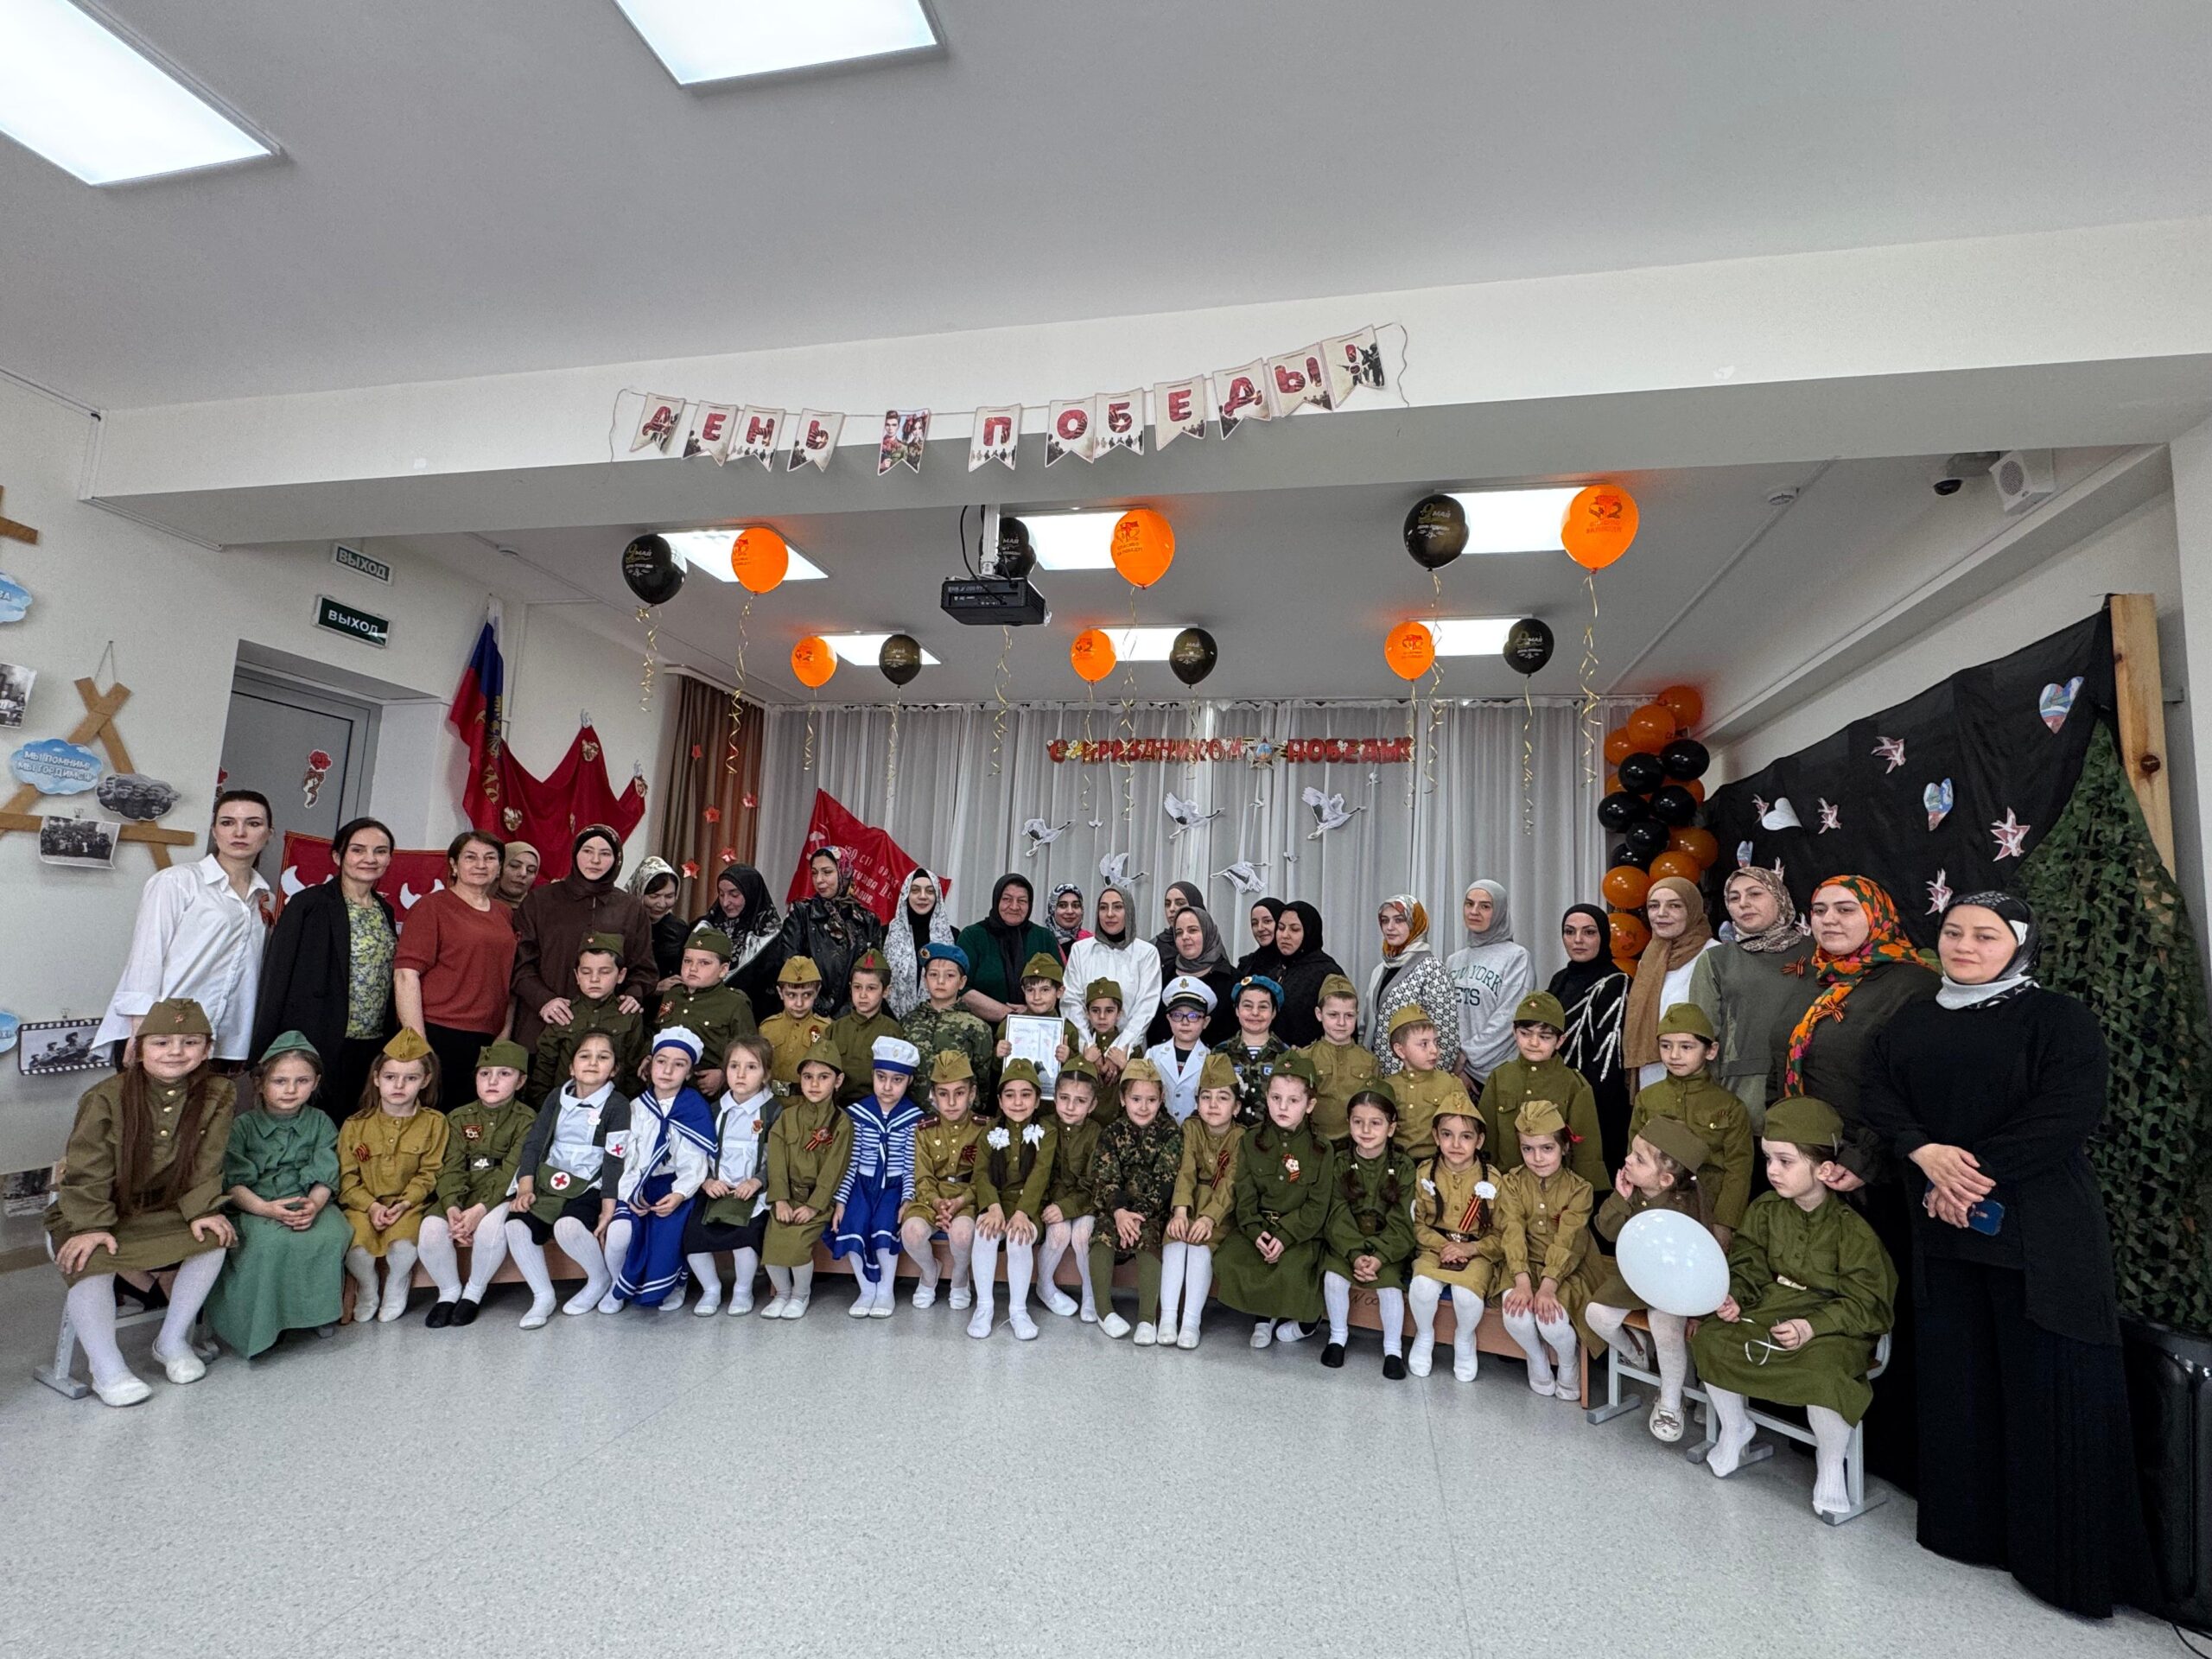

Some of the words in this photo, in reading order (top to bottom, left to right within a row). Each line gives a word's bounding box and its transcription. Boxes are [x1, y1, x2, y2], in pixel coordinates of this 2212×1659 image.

[641, 405, 830, 450] ДЕНЬ
[982, 344, 1362, 447] ПОБЕДЫ!
[338, 550, 387, 579] ВЫХОД
[327, 609, 379, 637] ВЫХОД
[1048, 739, 1068, 763] С
[1469, 965, 1503, 997] YORK
